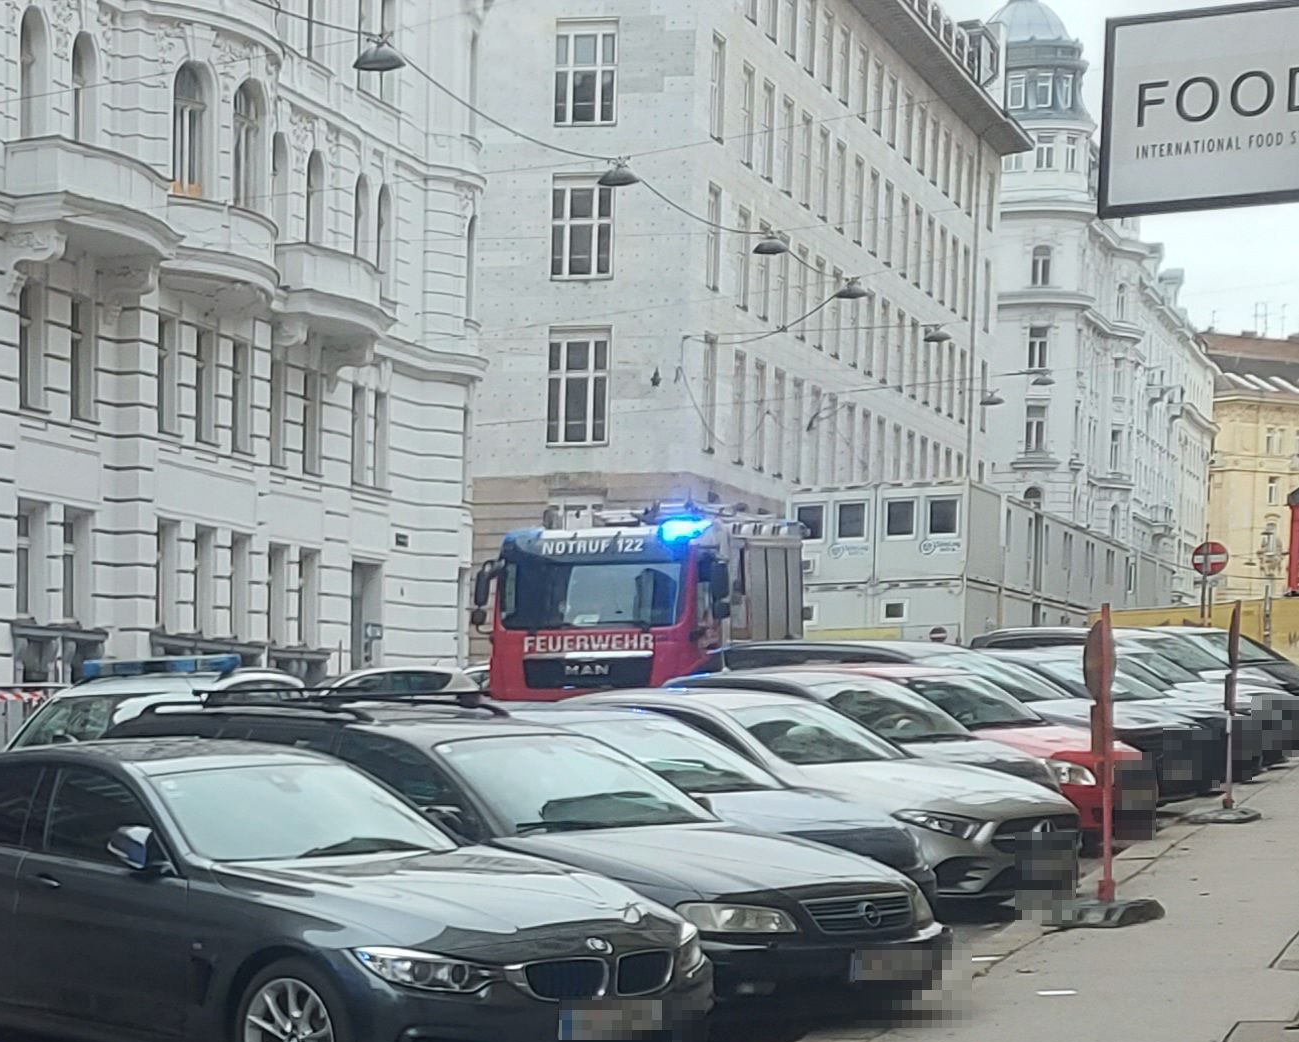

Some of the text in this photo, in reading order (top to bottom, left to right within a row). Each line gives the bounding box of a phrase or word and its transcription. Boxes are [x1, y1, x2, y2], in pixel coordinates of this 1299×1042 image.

[1136, 136, 1242, 160] INTERNATIONAL
[1248, 132, 1284, 150] FOOD
[542, 538, 644, 555] NOTRUF 122
[523, 633, 654, 653] FEUERWEHR
[564, 664, 610, 676] MAN
